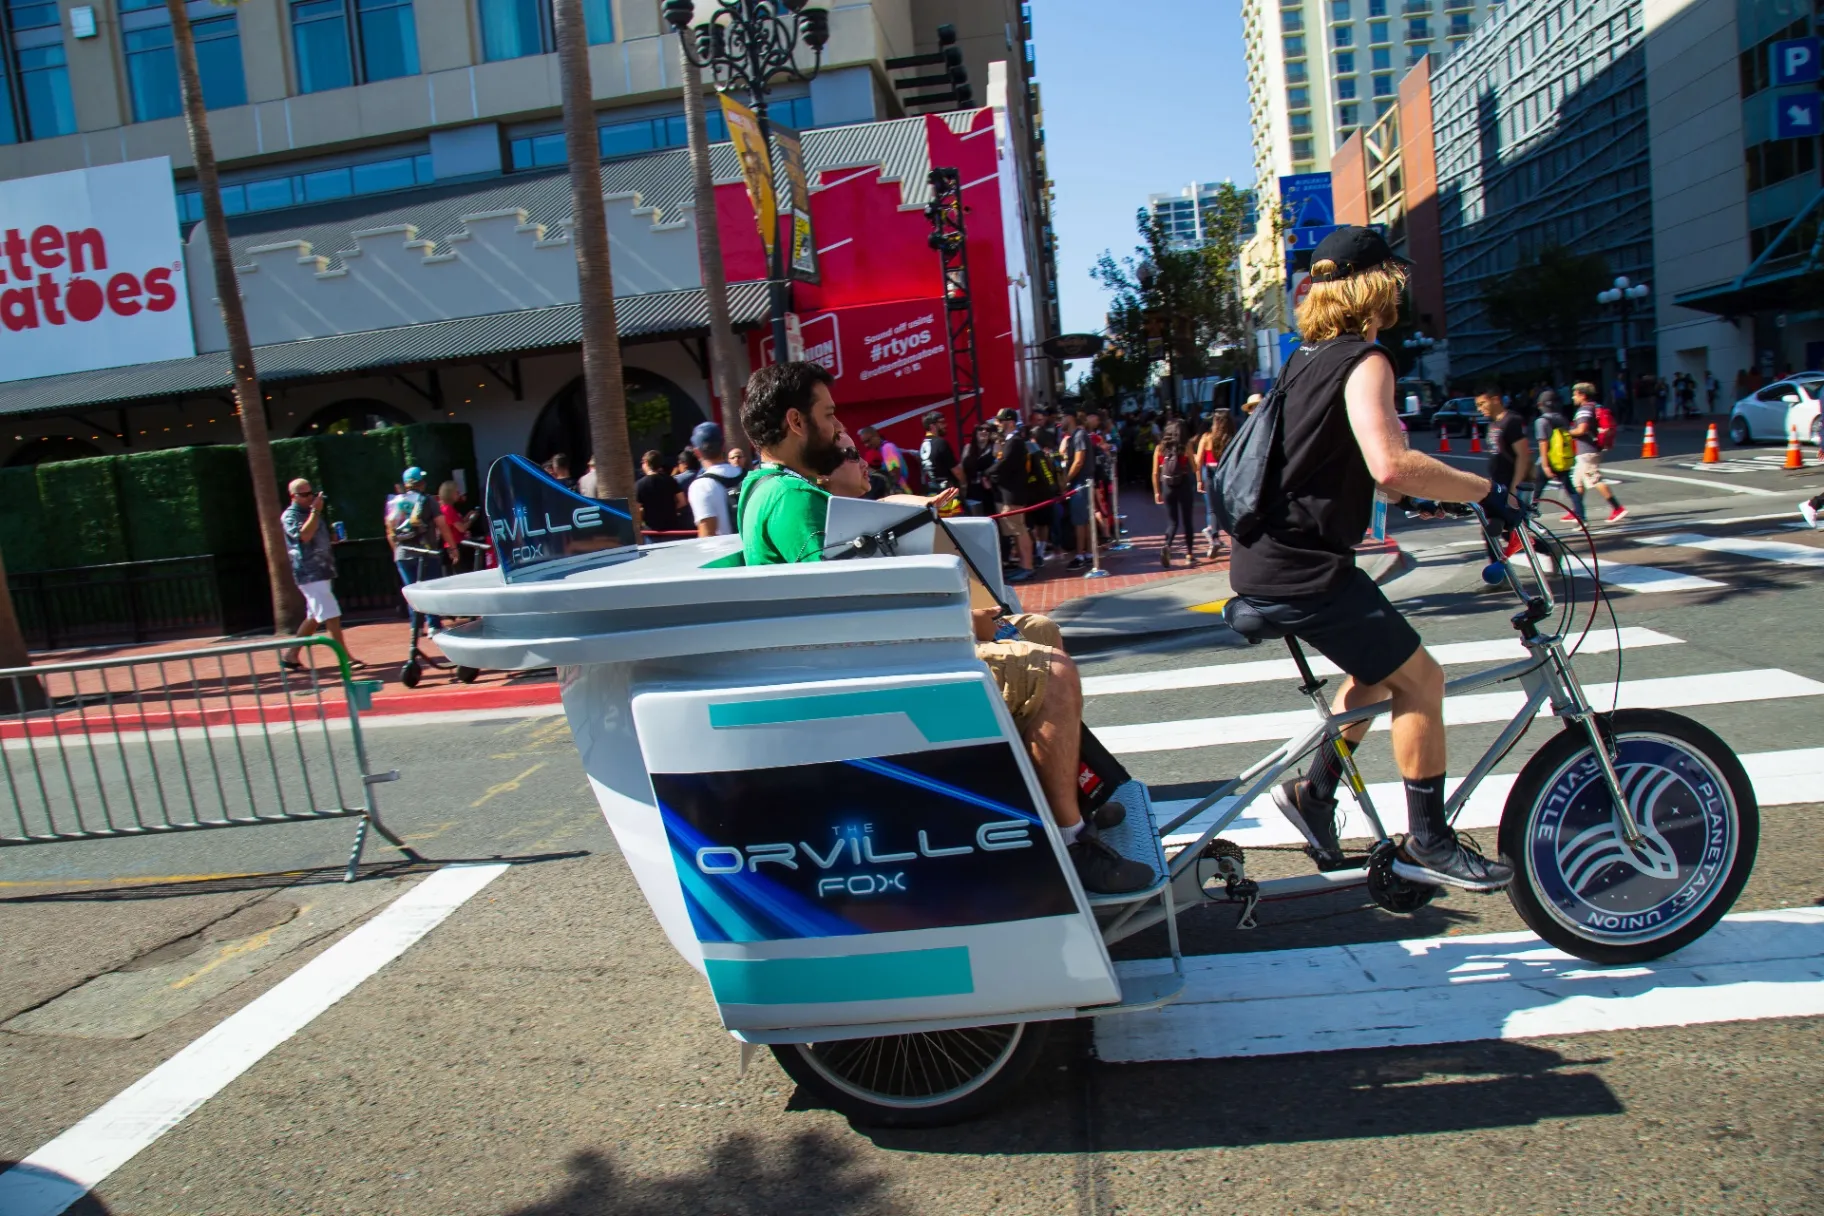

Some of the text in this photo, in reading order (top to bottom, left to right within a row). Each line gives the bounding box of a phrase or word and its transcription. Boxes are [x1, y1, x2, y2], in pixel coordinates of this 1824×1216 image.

[1785, 46, 1811, 76] P
[0, 267, 177, 332] atoes
[864, 313, 934, 345] Sound off using
[869, 330, 932, 362] #rtyos
[492, 505, 603, 541] RVILLE
[512, 543, 543, 563] FOX
[1538, 756, 1599, 841] RVILLE
[832, 823, 874, 836] THE
[696, 819, 1033, 875] ORVILLE
[818, 872, 906, 897] FOX
[1588, 911, 1662, 930] UNION
